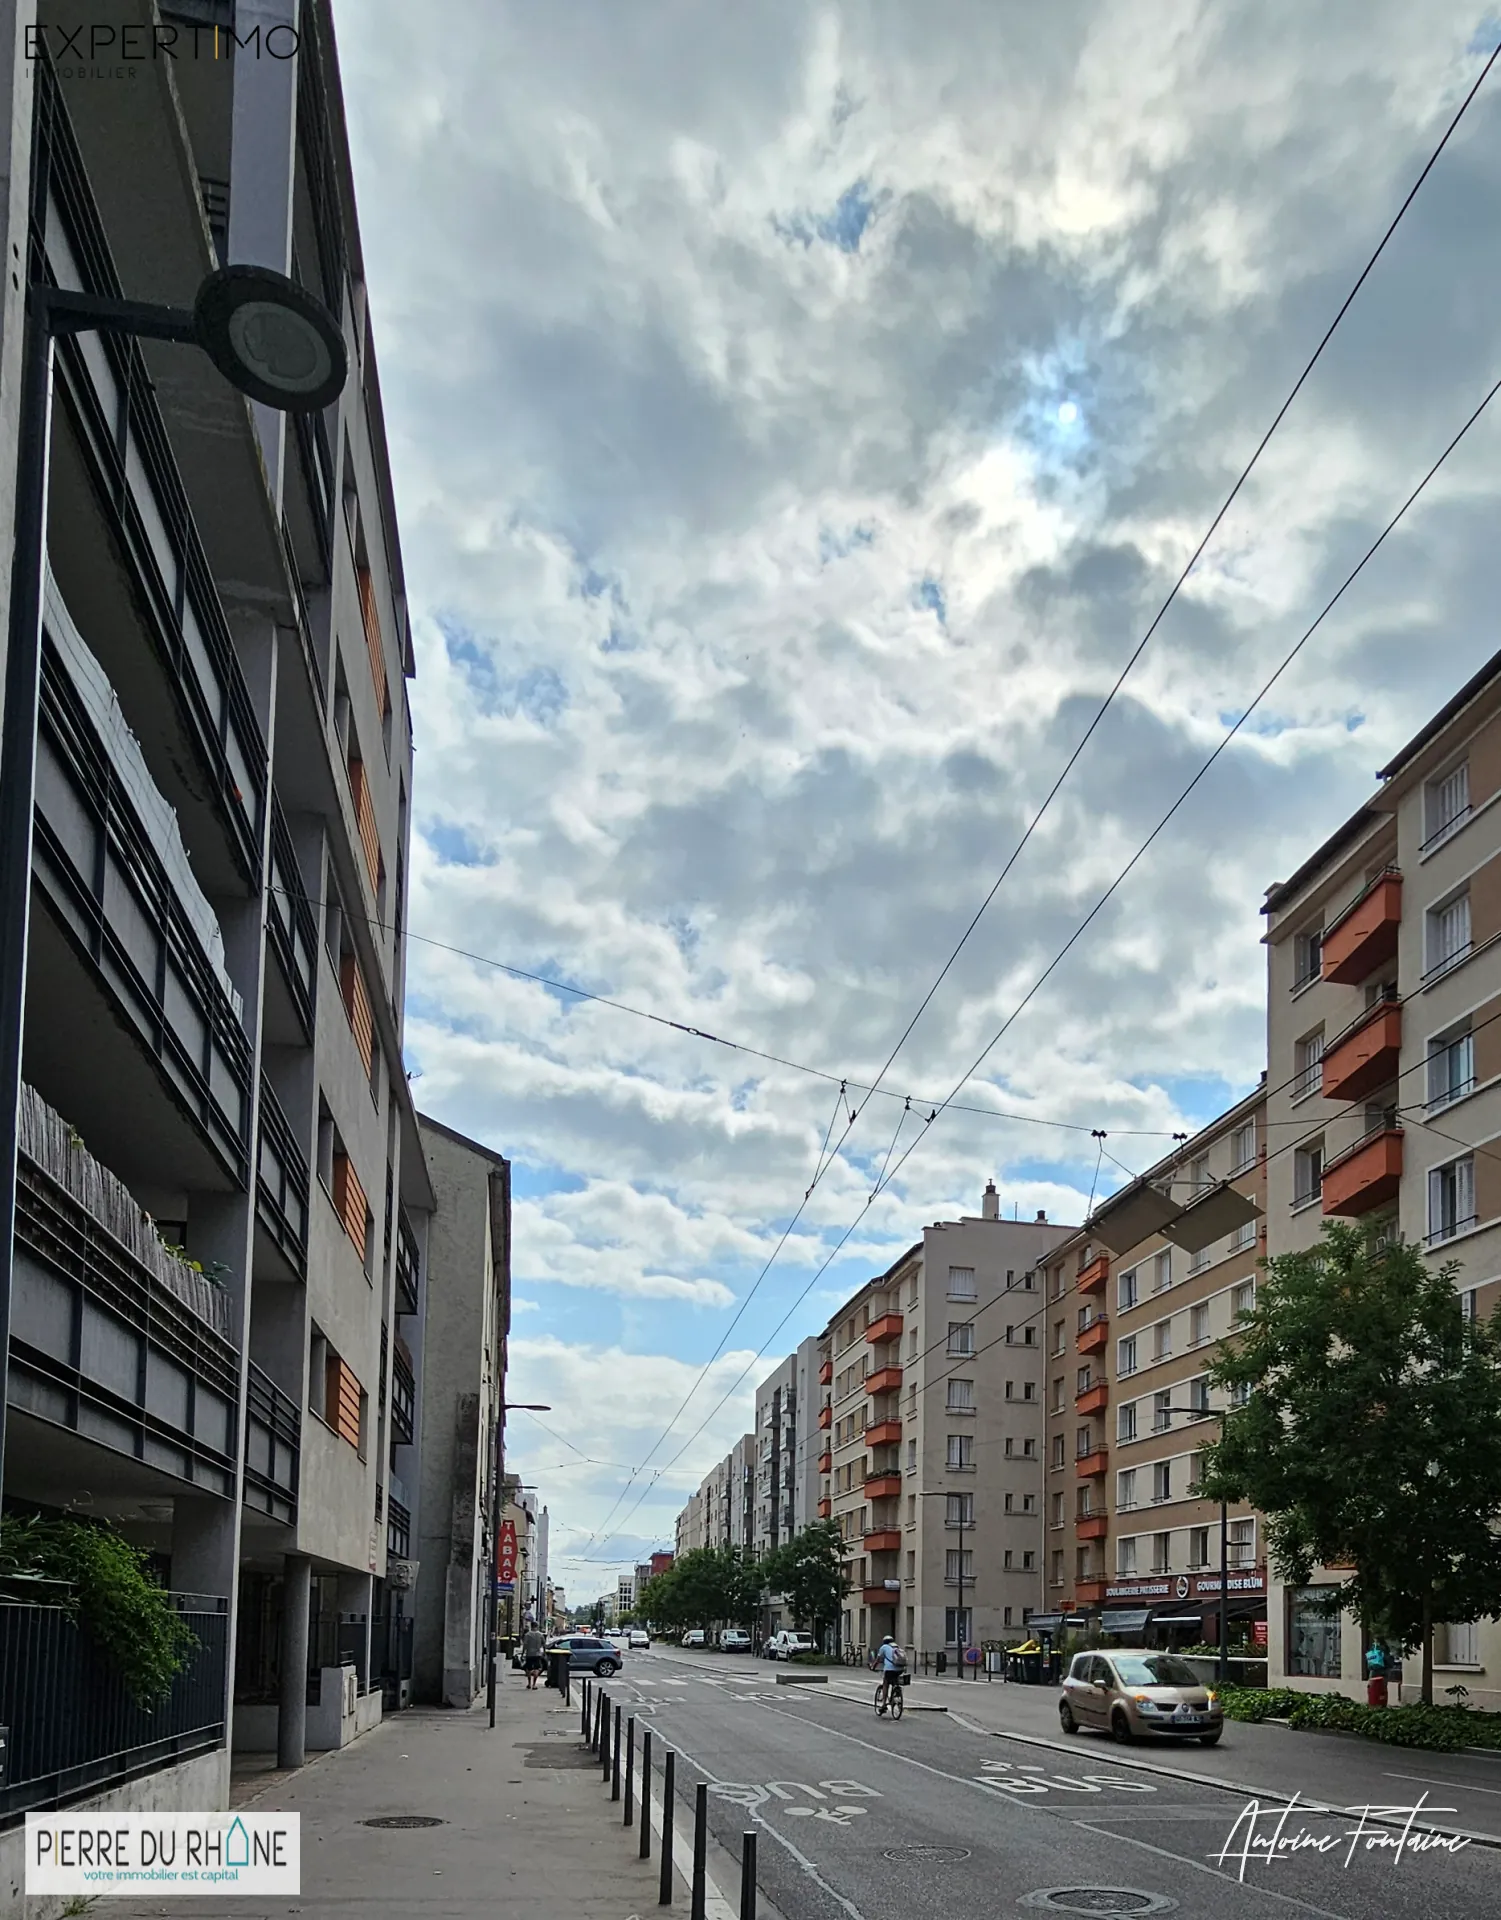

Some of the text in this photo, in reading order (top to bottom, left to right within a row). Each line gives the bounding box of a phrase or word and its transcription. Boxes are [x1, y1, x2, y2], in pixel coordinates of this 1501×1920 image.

[503, 1521, 513, 1578] TABAC
[706, 1780, 885, 1807] BUS
[972, 1775, 1158, 1793] BUS
